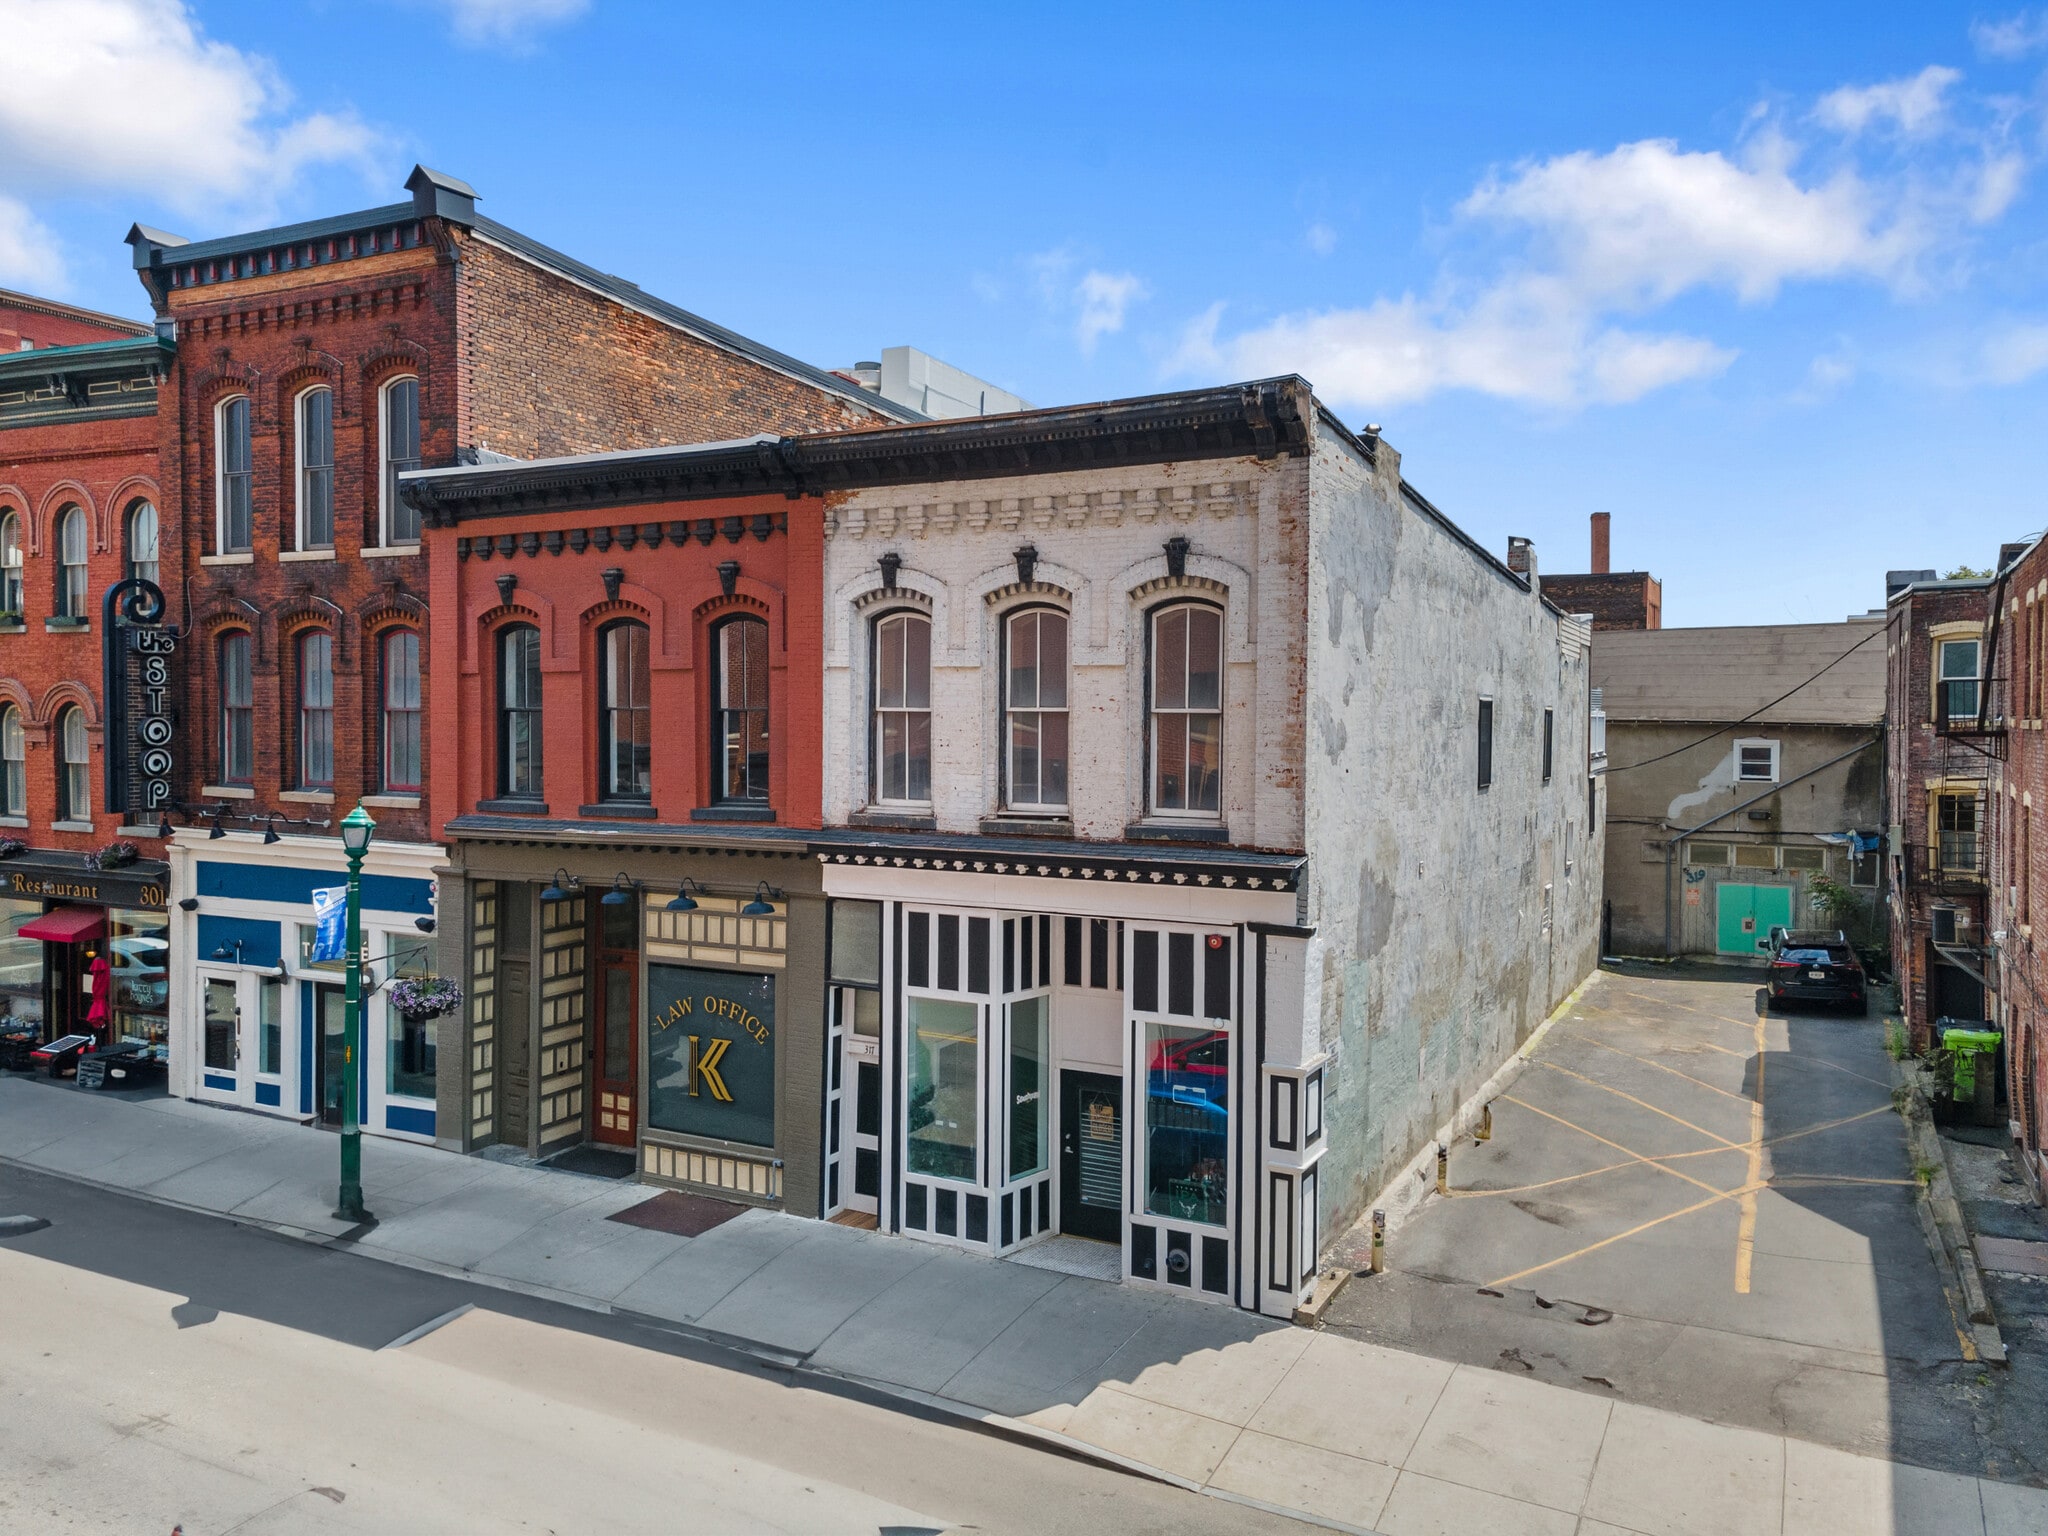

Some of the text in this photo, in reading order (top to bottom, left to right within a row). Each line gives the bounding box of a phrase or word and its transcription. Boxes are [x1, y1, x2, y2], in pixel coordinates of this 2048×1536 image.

[137, 630, 175, 653] the
[143, 656, 172, 809] STOOP
[12, 873, 166, 906] Restaurant 301
[1686, 869, 1706, 883] 319
[656, 995, 770, 1045] LAW OFFICE
[864, 1045, 875, 1055] 317
[687, 1035, 734, 1102] K
